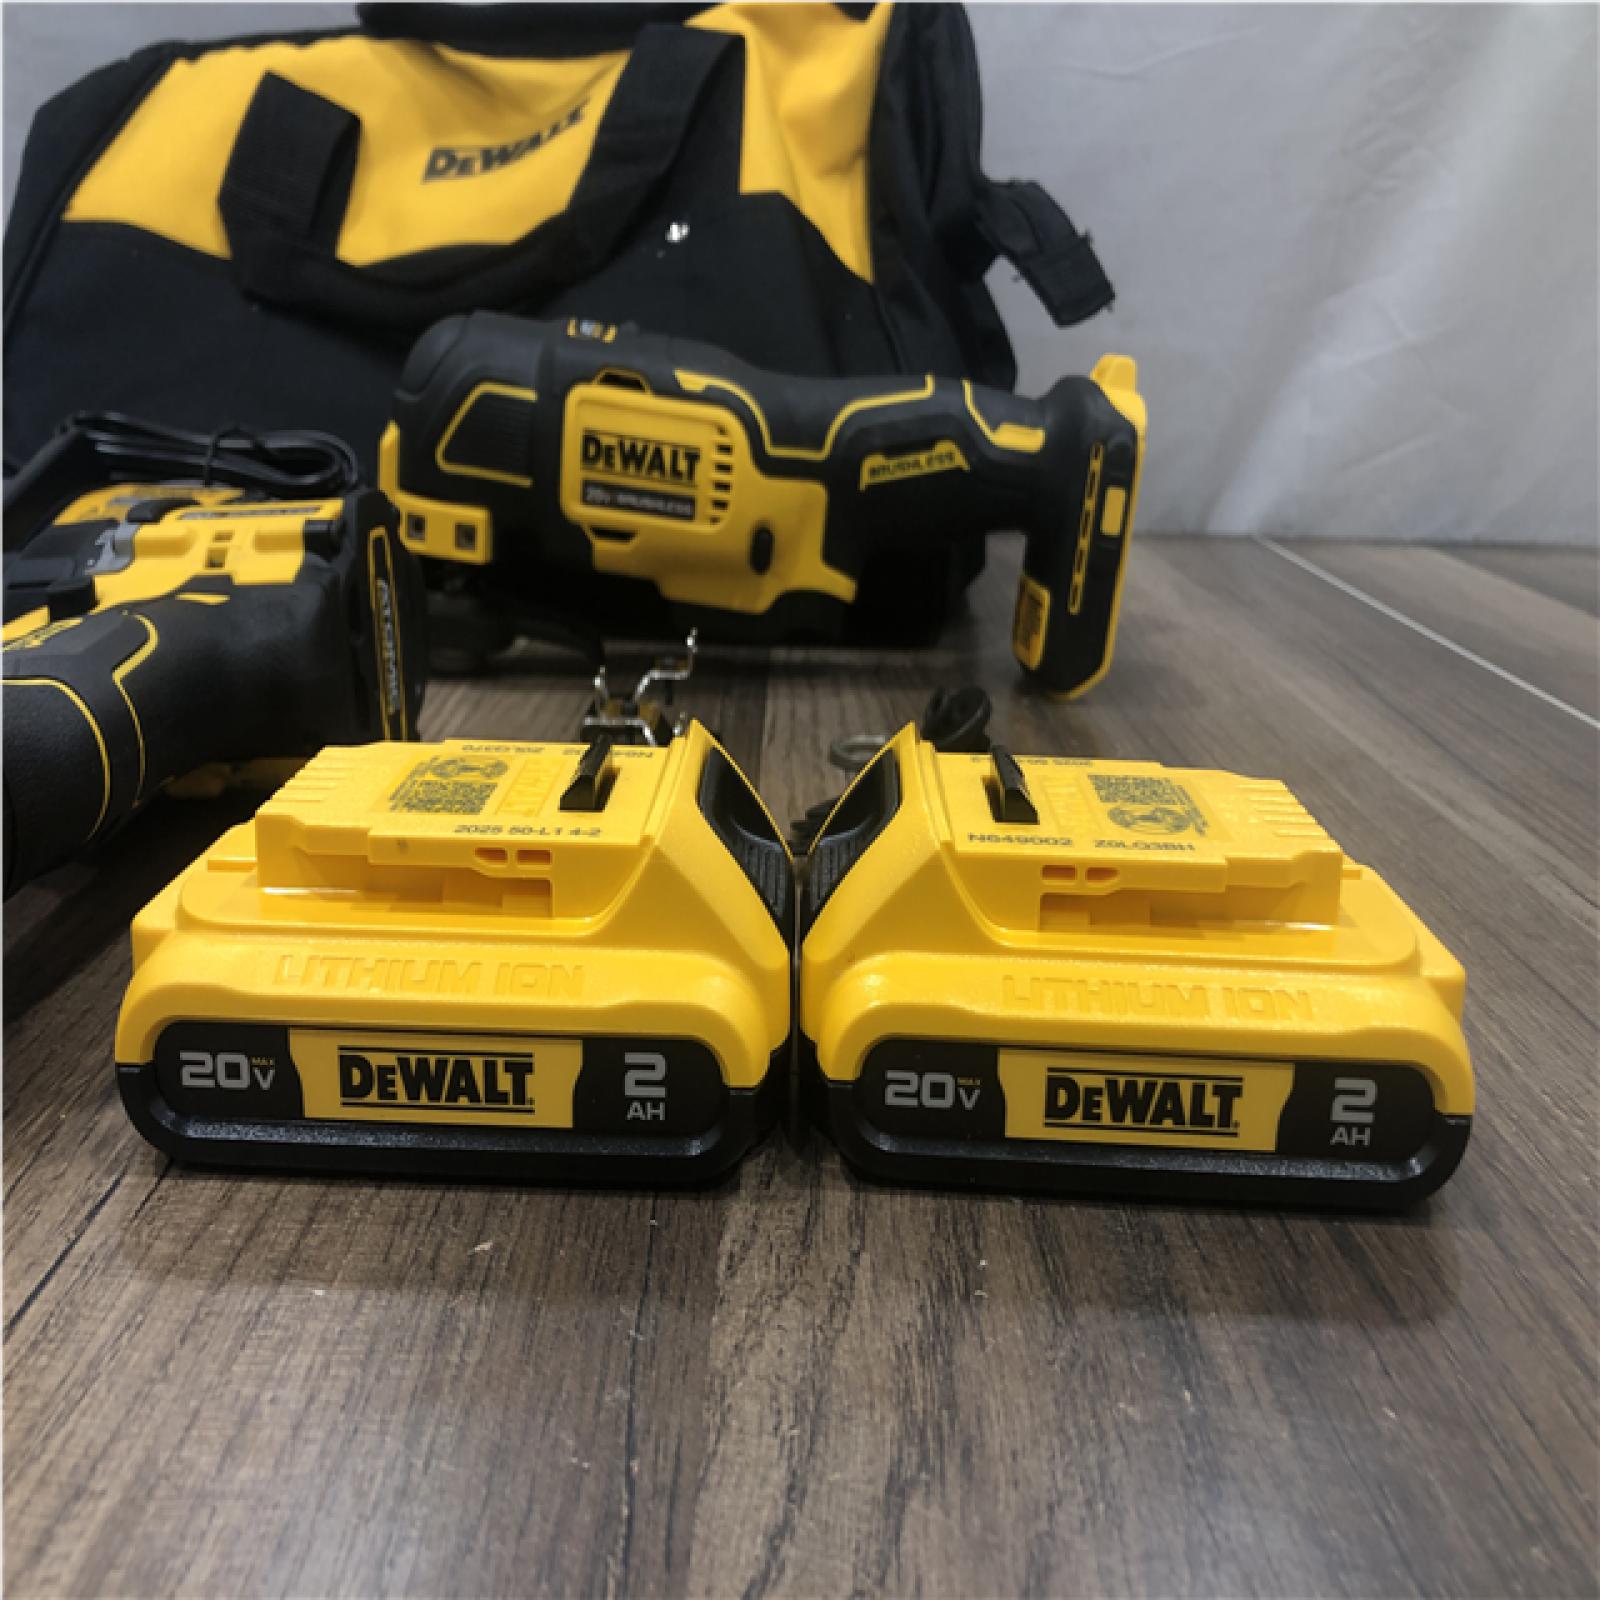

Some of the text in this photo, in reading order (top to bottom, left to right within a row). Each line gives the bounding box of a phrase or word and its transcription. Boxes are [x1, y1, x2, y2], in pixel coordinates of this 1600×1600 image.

[273, 954, 584, 997] LITHIUM ION
[1002, 974, 1314, 1021] LITHIUM ION
[623, 1051, 667, 1099] 2
[626, 1101, 667, 1122] AH
[1330, 1076, 1378, 1125] 2
[1329, 1127, 1371, 1147] AH
